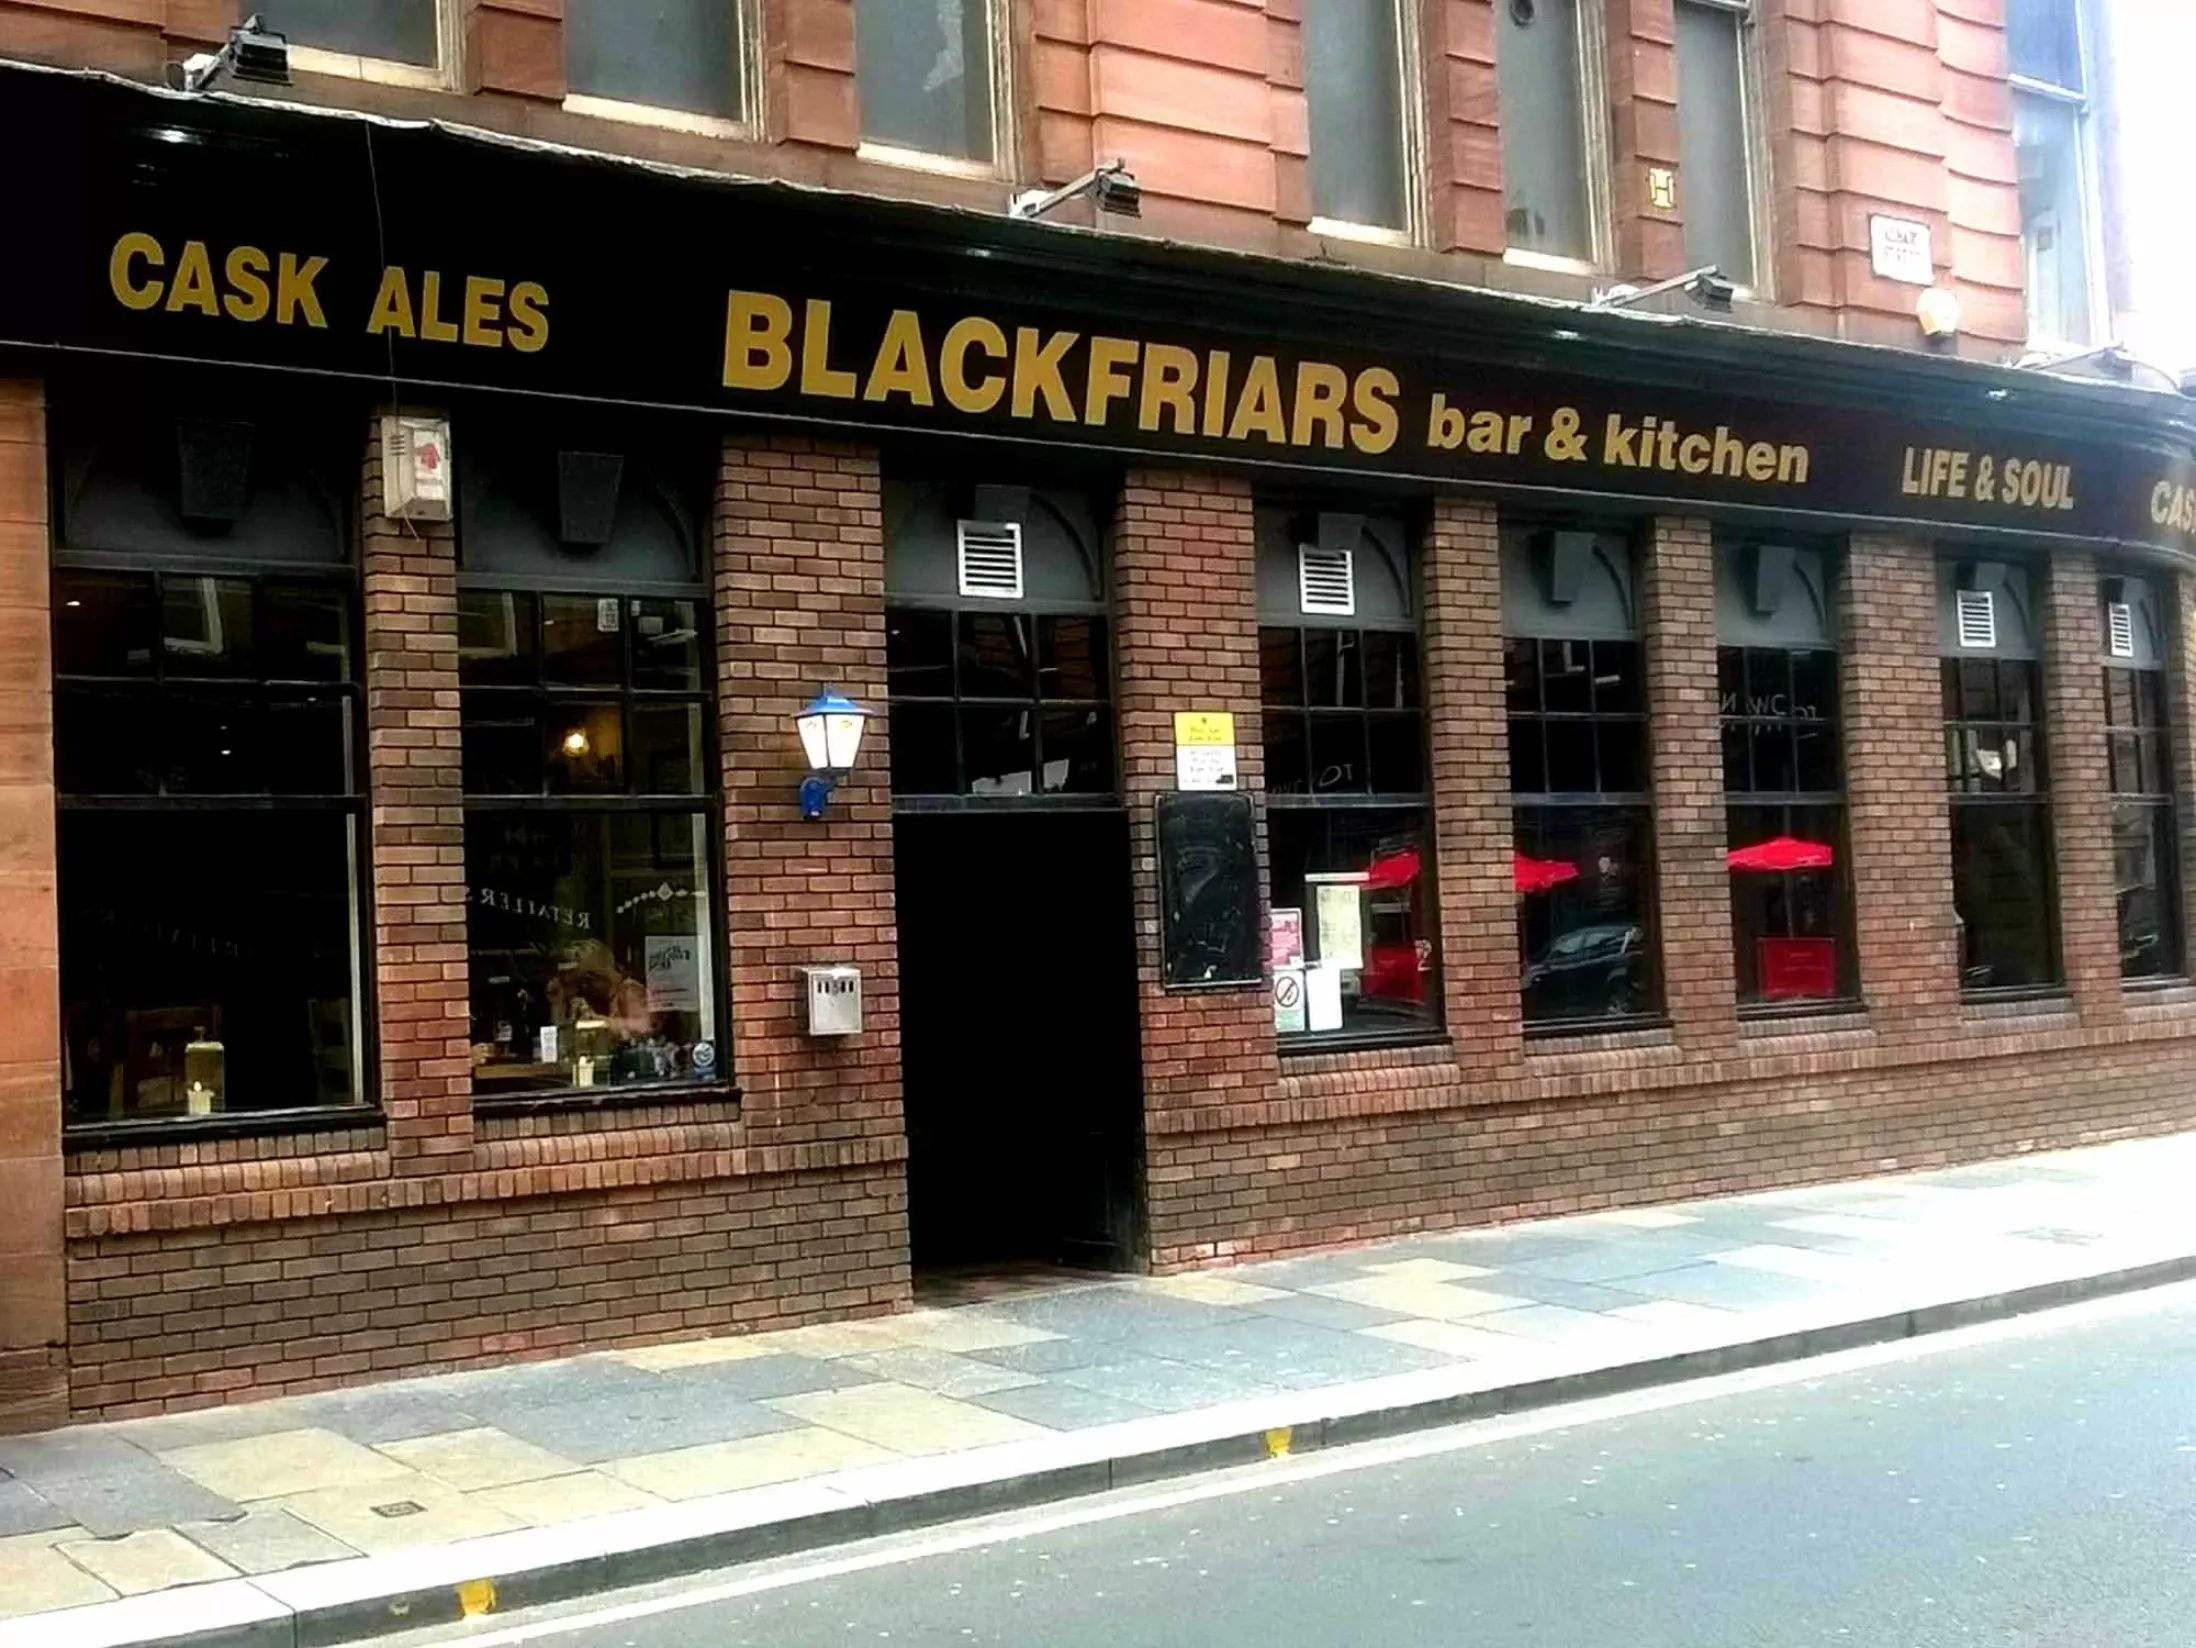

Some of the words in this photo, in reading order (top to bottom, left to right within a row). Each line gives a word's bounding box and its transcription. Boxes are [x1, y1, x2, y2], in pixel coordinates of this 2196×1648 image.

[109, 232, 328, 328] CASK
[367, 266, 550, 352] ALES
[722, 290, 1400, 455] BLACKFRIARS
[1427, 393, 1532, 454] bar
[1543, 406, 1587, 463] &
[1604, 414, 1809, 483] kitchen
[1902, 447, 1970, 498] LIFE
[1975, 455, 1995, 501] &
[2002, 457, 2074, 511] SOUL
[2151, 480, 2196, 535] CAS
